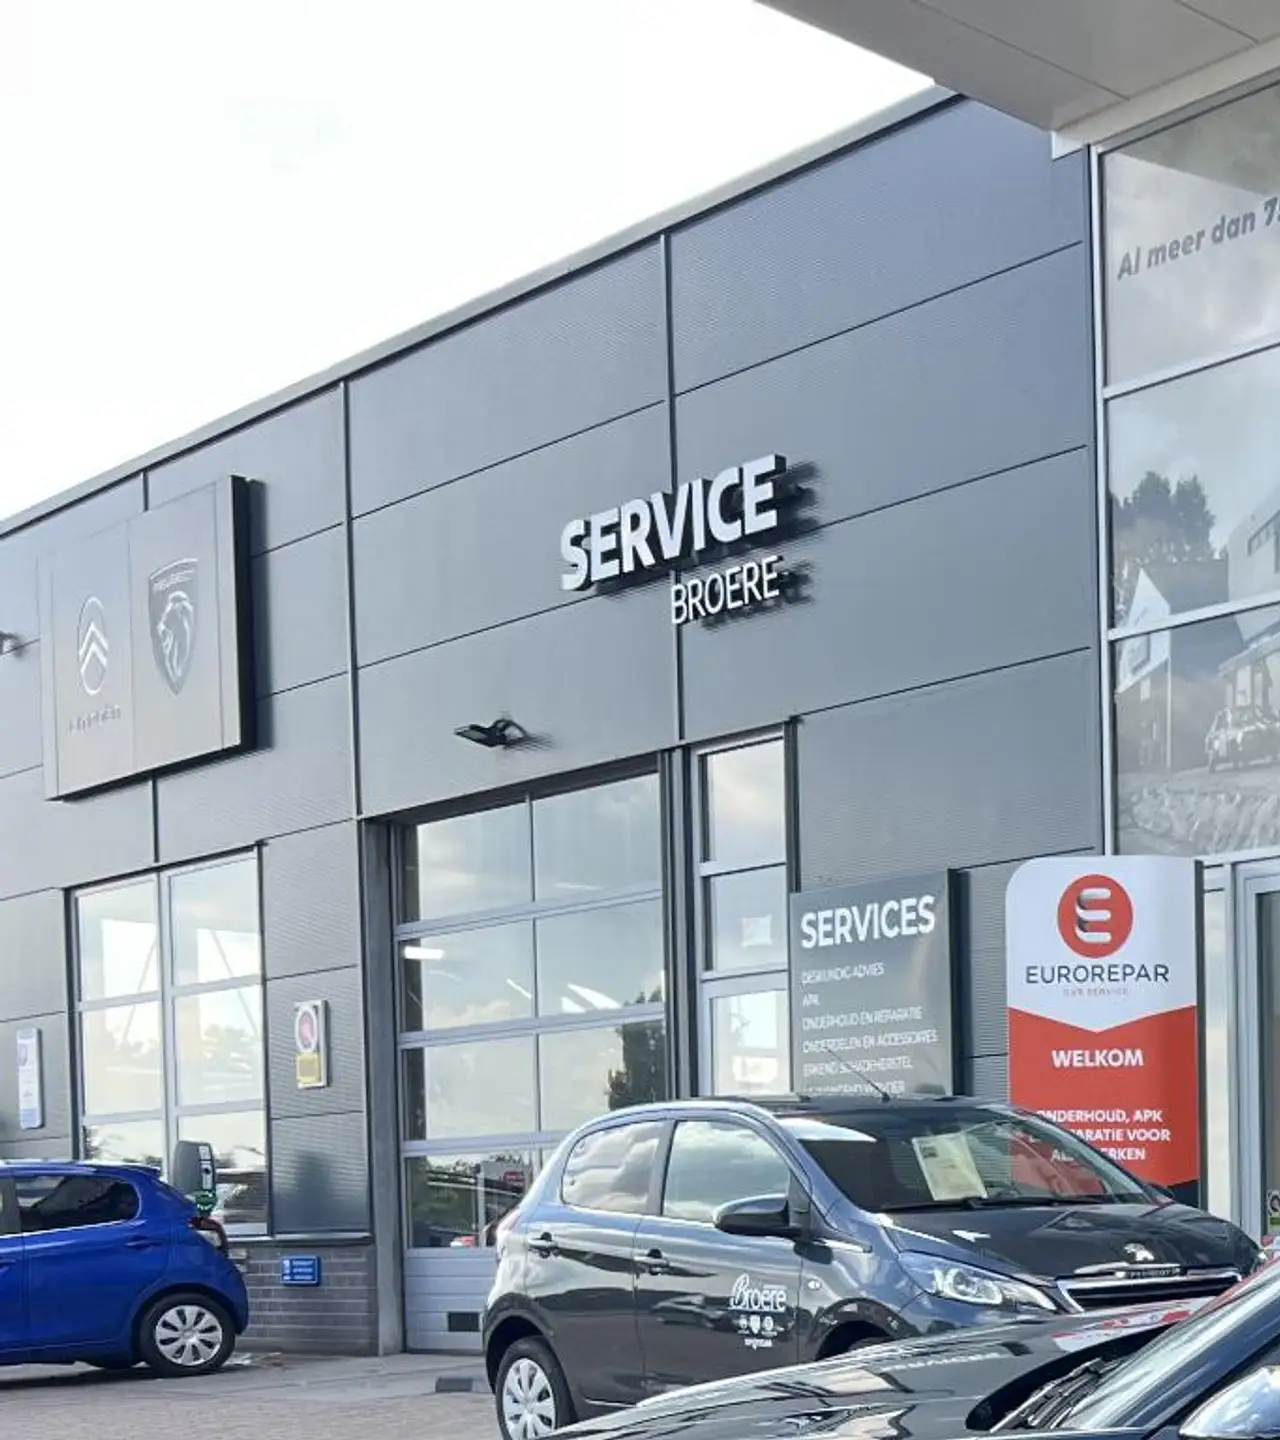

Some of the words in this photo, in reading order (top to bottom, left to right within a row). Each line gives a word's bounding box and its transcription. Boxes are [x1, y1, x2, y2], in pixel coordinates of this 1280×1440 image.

[1117, 246, 1141, 281] Al
[1146, 228, 1206, 270] meer
[1210, 210, 1256, 246] dan
[560, 452, 782, 592] SERVICE
[670, 554, 781, 625] BROERE
[800, 895, 936, 949] SERVICES
[1026, 964, 1169, 984] EUROREPAR
[1052, 1048, 1144, 1068] WELKOM
[1127, 1128, 1171, 1142] VOOR
[1133, 1109, 1163, 1122] APK
[728, 1273, 787, 1312] Broere
